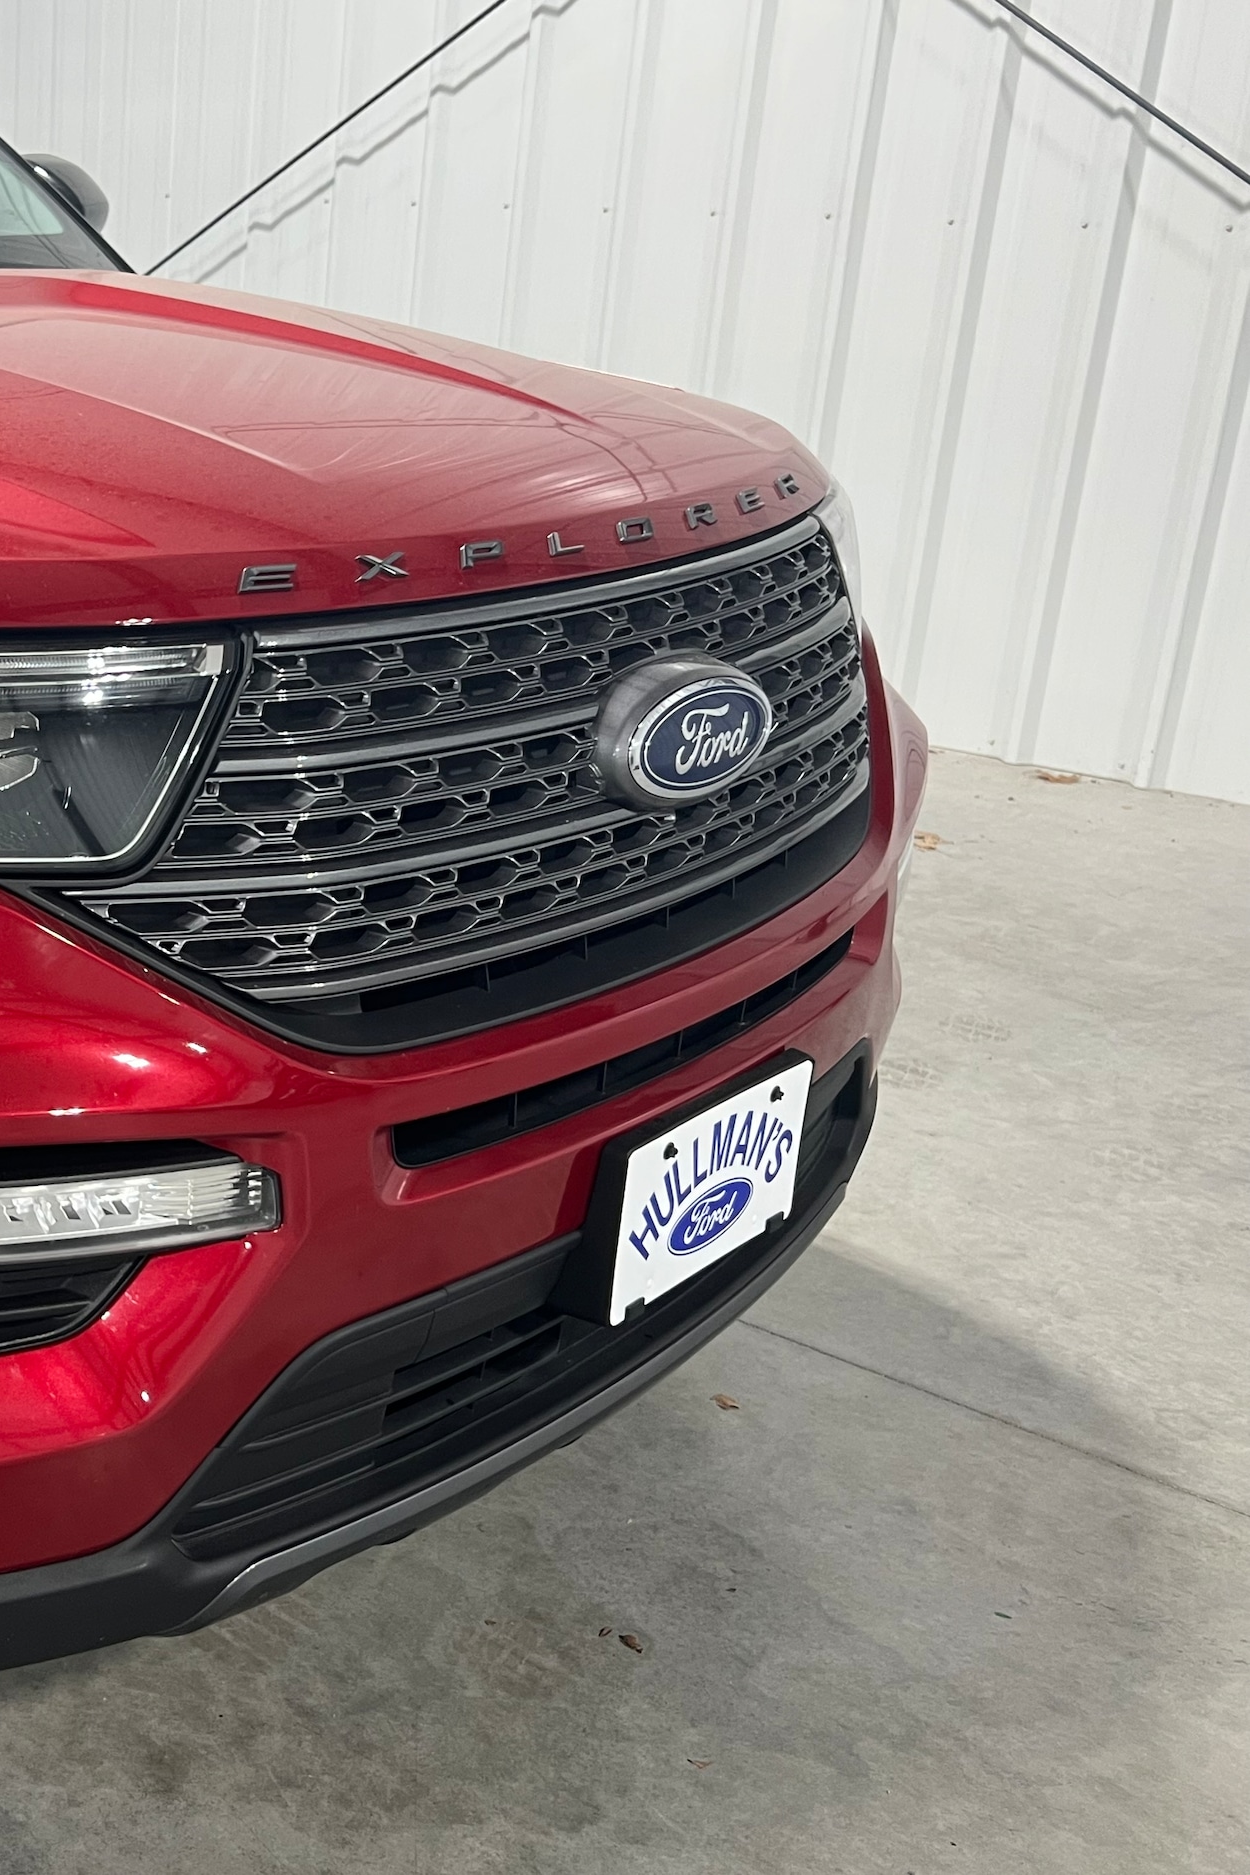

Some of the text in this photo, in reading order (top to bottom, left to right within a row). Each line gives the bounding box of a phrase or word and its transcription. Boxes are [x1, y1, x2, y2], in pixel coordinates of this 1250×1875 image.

[236, 473, 800, 596] EXPLORER
[675, 702, 749, 776] Ford
[628, 1110, 793, 1261] HULLMAN'S
[683, 1189, 738, 1245] Ford
